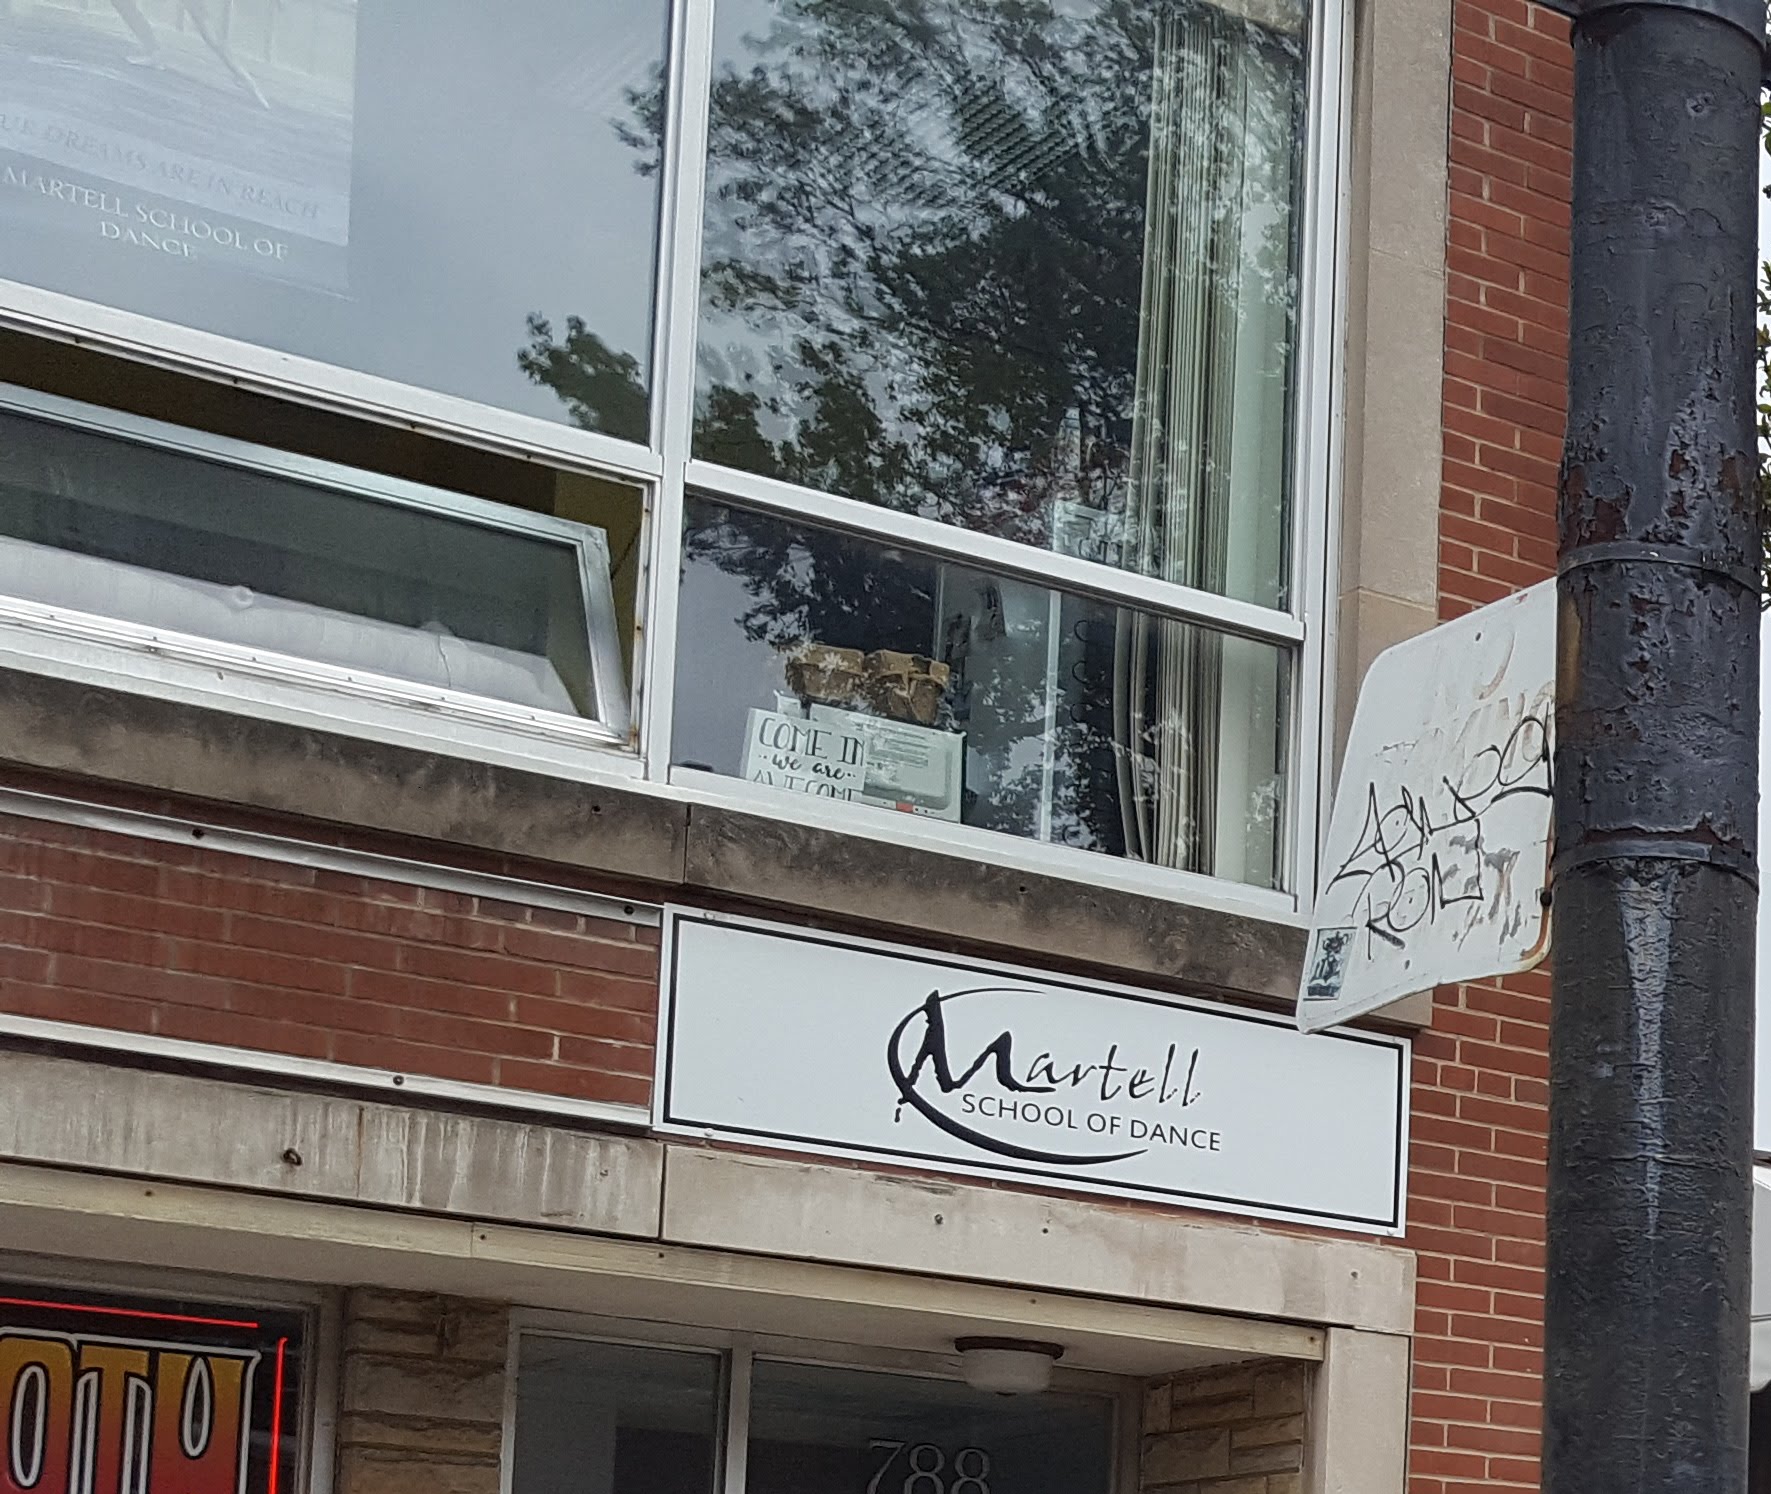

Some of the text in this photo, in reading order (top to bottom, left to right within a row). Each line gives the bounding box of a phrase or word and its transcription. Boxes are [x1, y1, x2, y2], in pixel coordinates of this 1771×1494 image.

[3, 165, 289, 260] MARTELL SCHOOL OF
[100, 221, 197, 259] DANCE
[758, 716, 866, 767] COME IN
[897, 988, 1202, 1107] Martell
[961, 1093, 1221, 1152] SCHOOL OF DANCE
